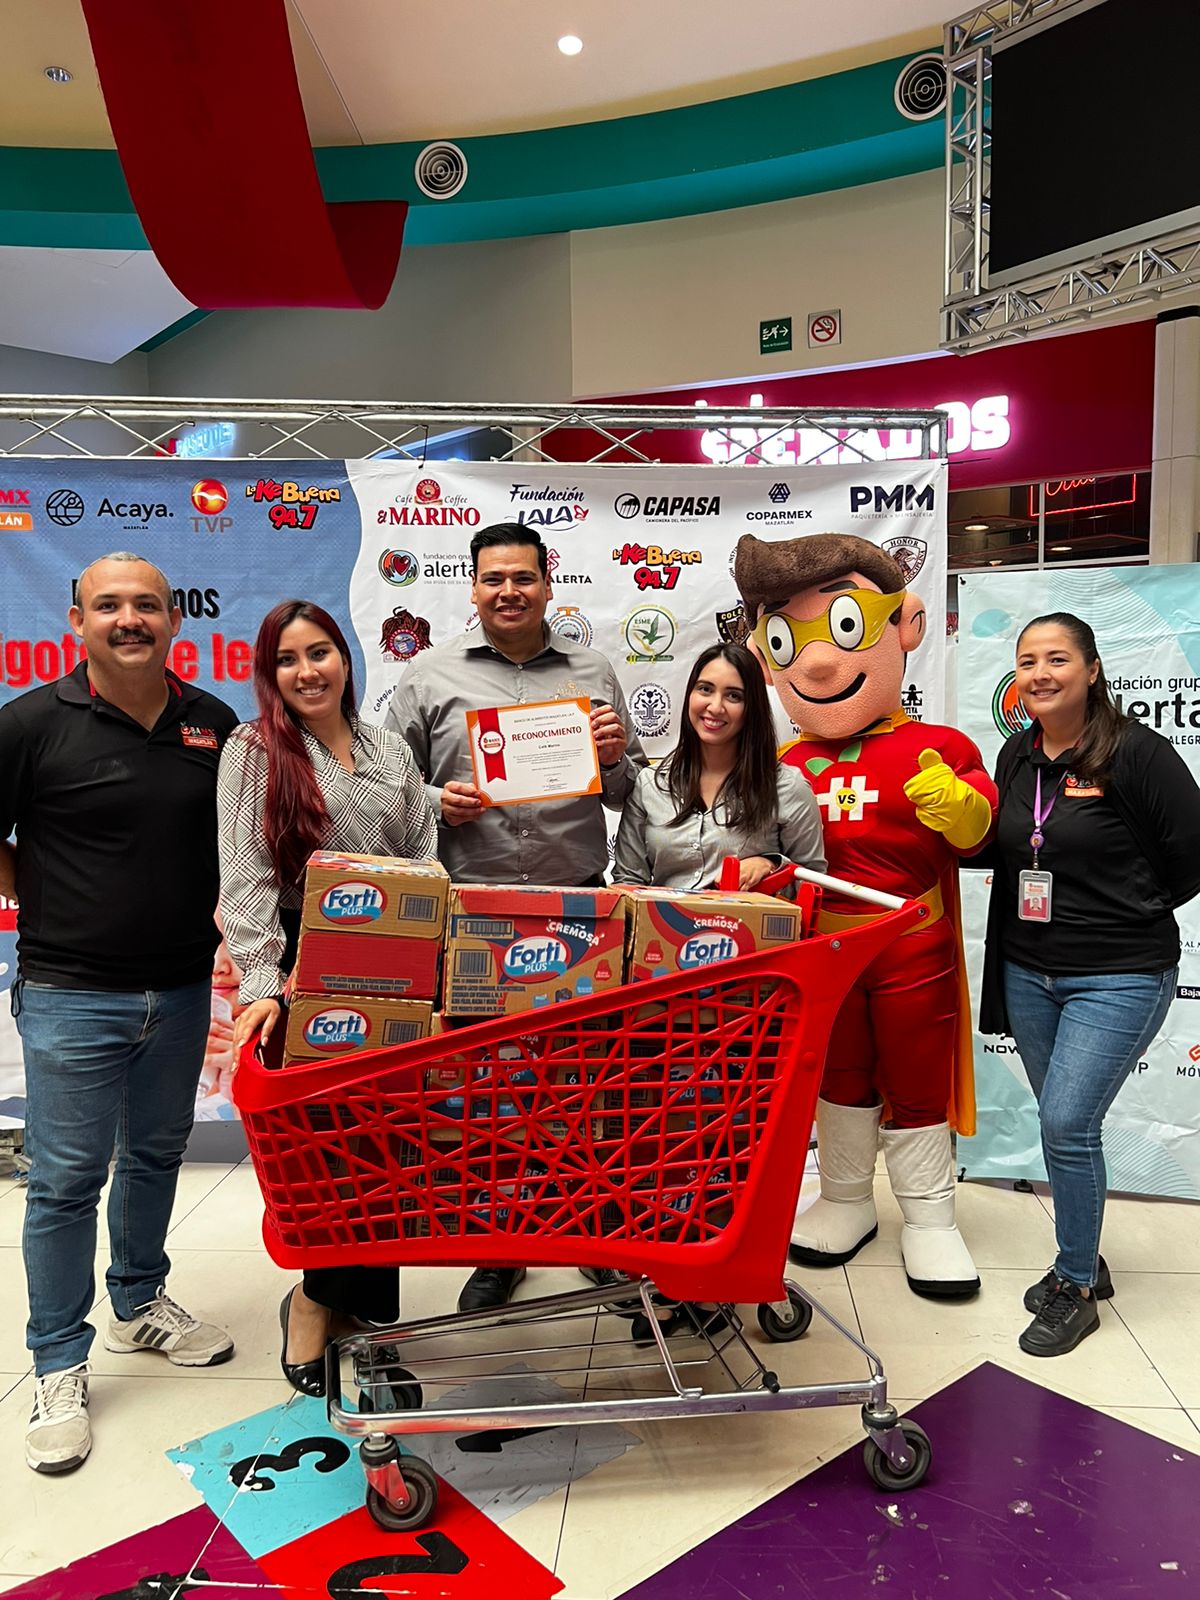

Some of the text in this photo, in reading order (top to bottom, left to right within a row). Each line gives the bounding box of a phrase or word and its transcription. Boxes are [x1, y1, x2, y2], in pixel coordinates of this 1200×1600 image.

[395, 494, 469, 507] Café Coffee
[510, 483, 585, 503] Fundación
[850, 484, 934, 512] PMM
[97, 497, 175, 523] Acaya.
[388, 506, 481, 526] MARINO
[518, 505, 574, 525] LALA
[643, 496, 720, 516] CAPASA
[746, 510, 813, 521] COPARMEX
[190, 517, 234, 533] TVP
[268, 504, 319, 530] 94.7
[890, 538, 919, 547] HONOR
[633, 566, 682, 591] 94.7
[373, 688, 393, 713] Colegio
[511, 726, 582, 742] RECONOCIMIENTO
[328, 888, 378, 908] Forti
[341, 906, 363, 916] PLUS
[548, 921, 600, 946] CREMOSA
[695, 918, 739, 930] CREMOSA
[509, 941, 560, 966] Forti
[684, 937, 733, 961] Forti
[524, 962, 547, 973] PLUS
[312, 1015, 361, 1036] Forti
[325, 1033, 347, 1043] PLUS
